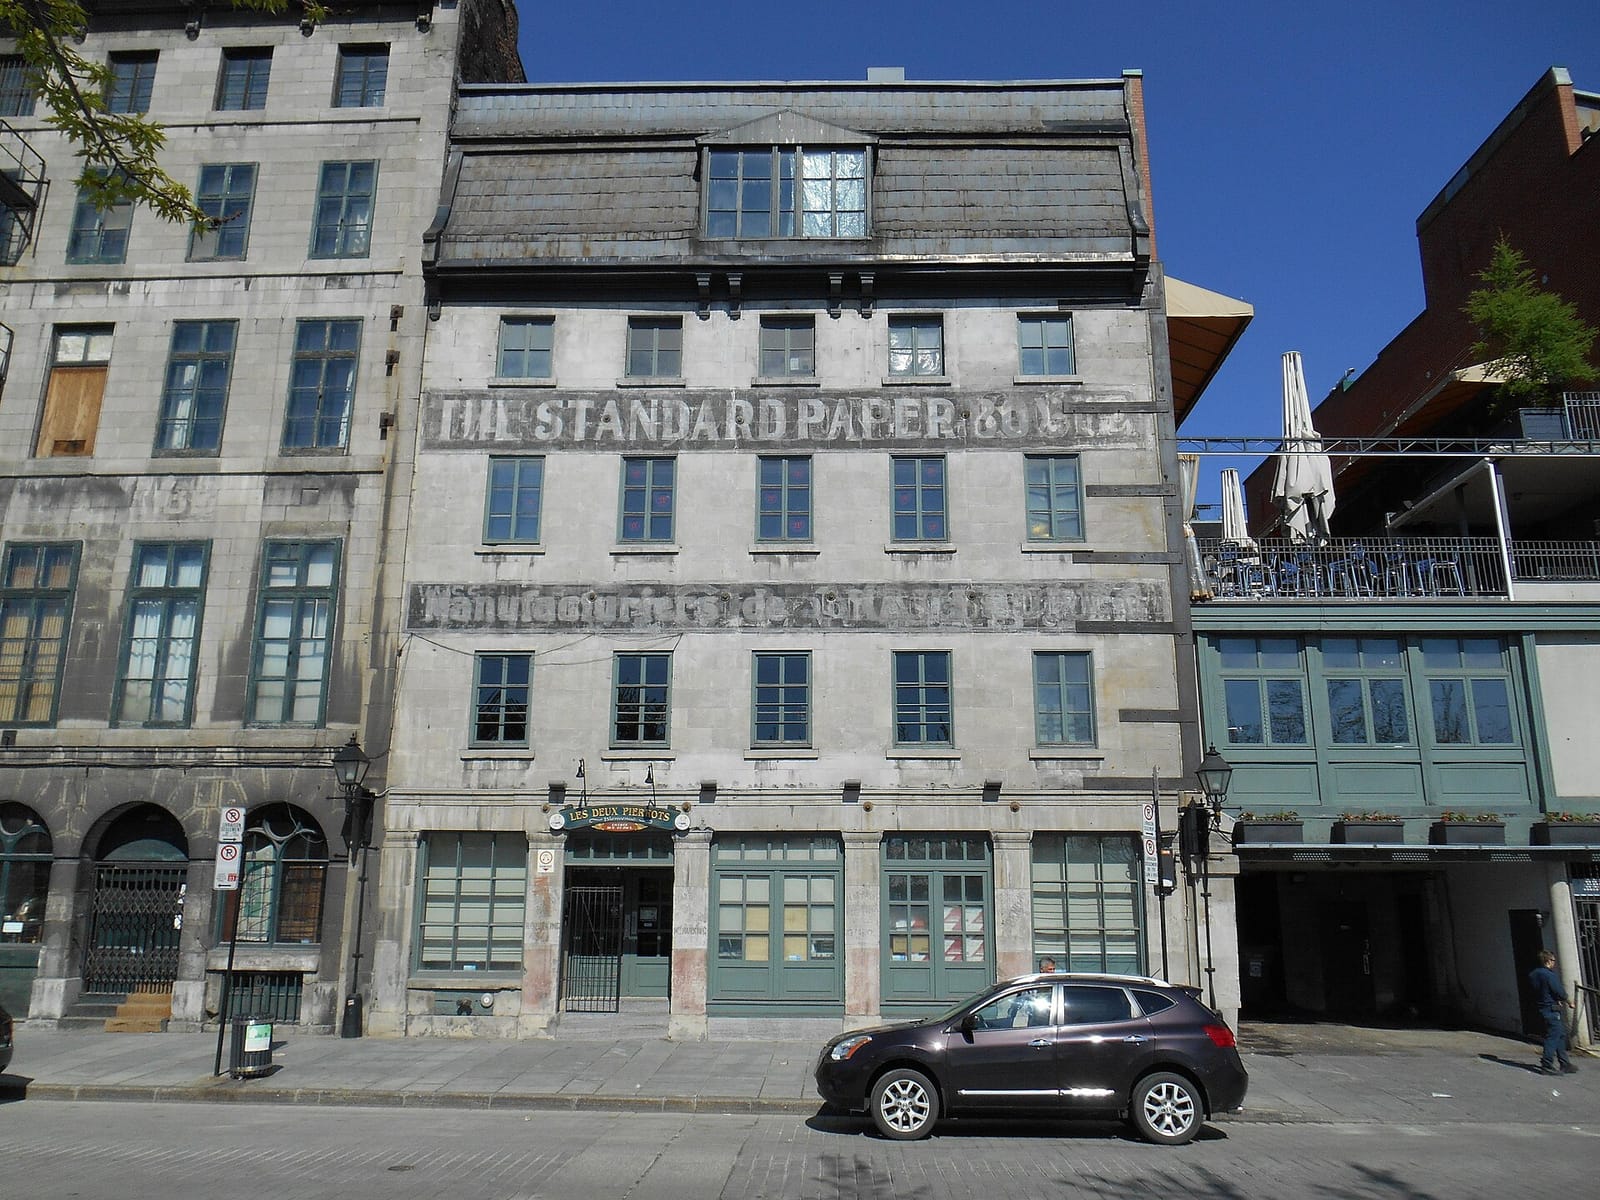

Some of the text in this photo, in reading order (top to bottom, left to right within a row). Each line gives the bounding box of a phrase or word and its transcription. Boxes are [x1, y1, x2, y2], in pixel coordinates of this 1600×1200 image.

[534, 398, 786, 441] STANDARD
[799, 398, 955, 441] PAPER
[570, 810, 588, 821] LES
[592, 807, 618, 818] DEUX
